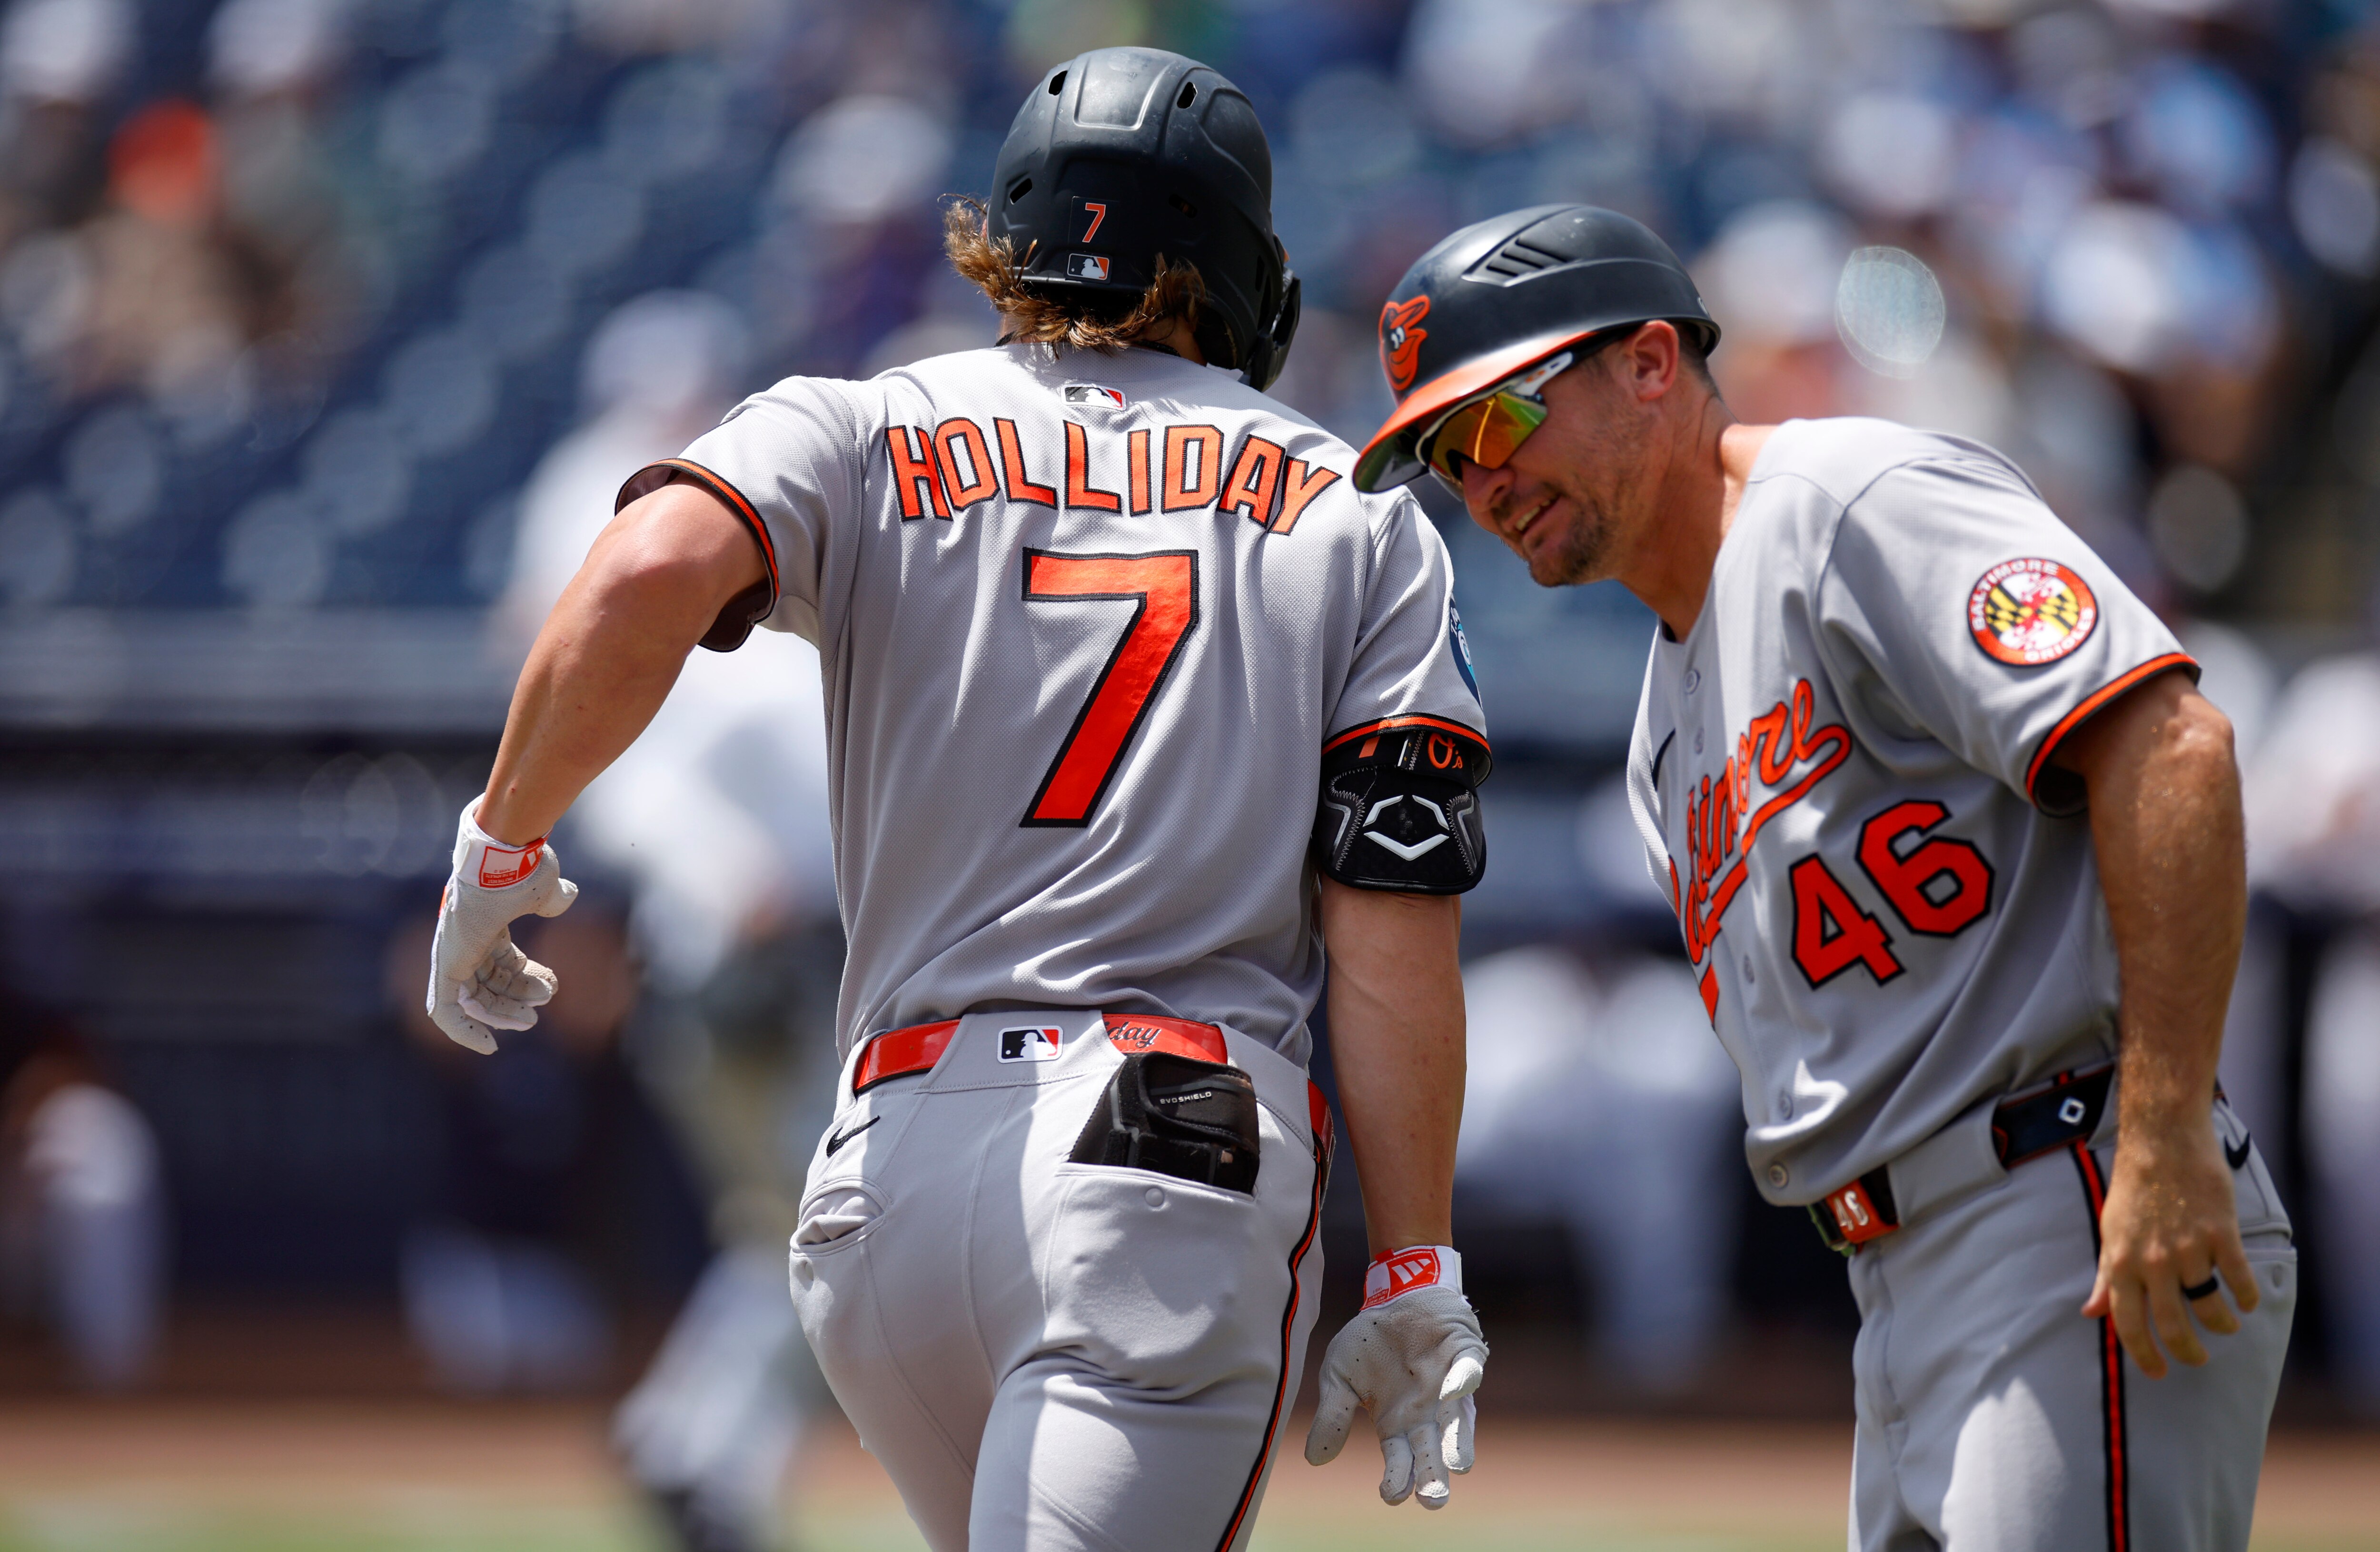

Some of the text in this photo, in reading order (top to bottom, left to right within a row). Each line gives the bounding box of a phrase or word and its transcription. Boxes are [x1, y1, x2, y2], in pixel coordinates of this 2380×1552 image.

[1082, 202, 1106, 243] 7
[885, 416, 1342, 535] HOLLIDAY
[1971, 559, 2059, 632] BALTIMORE
[1019, 546, 1199, 828] 7
[1788, 799, 1995, 991] 46
